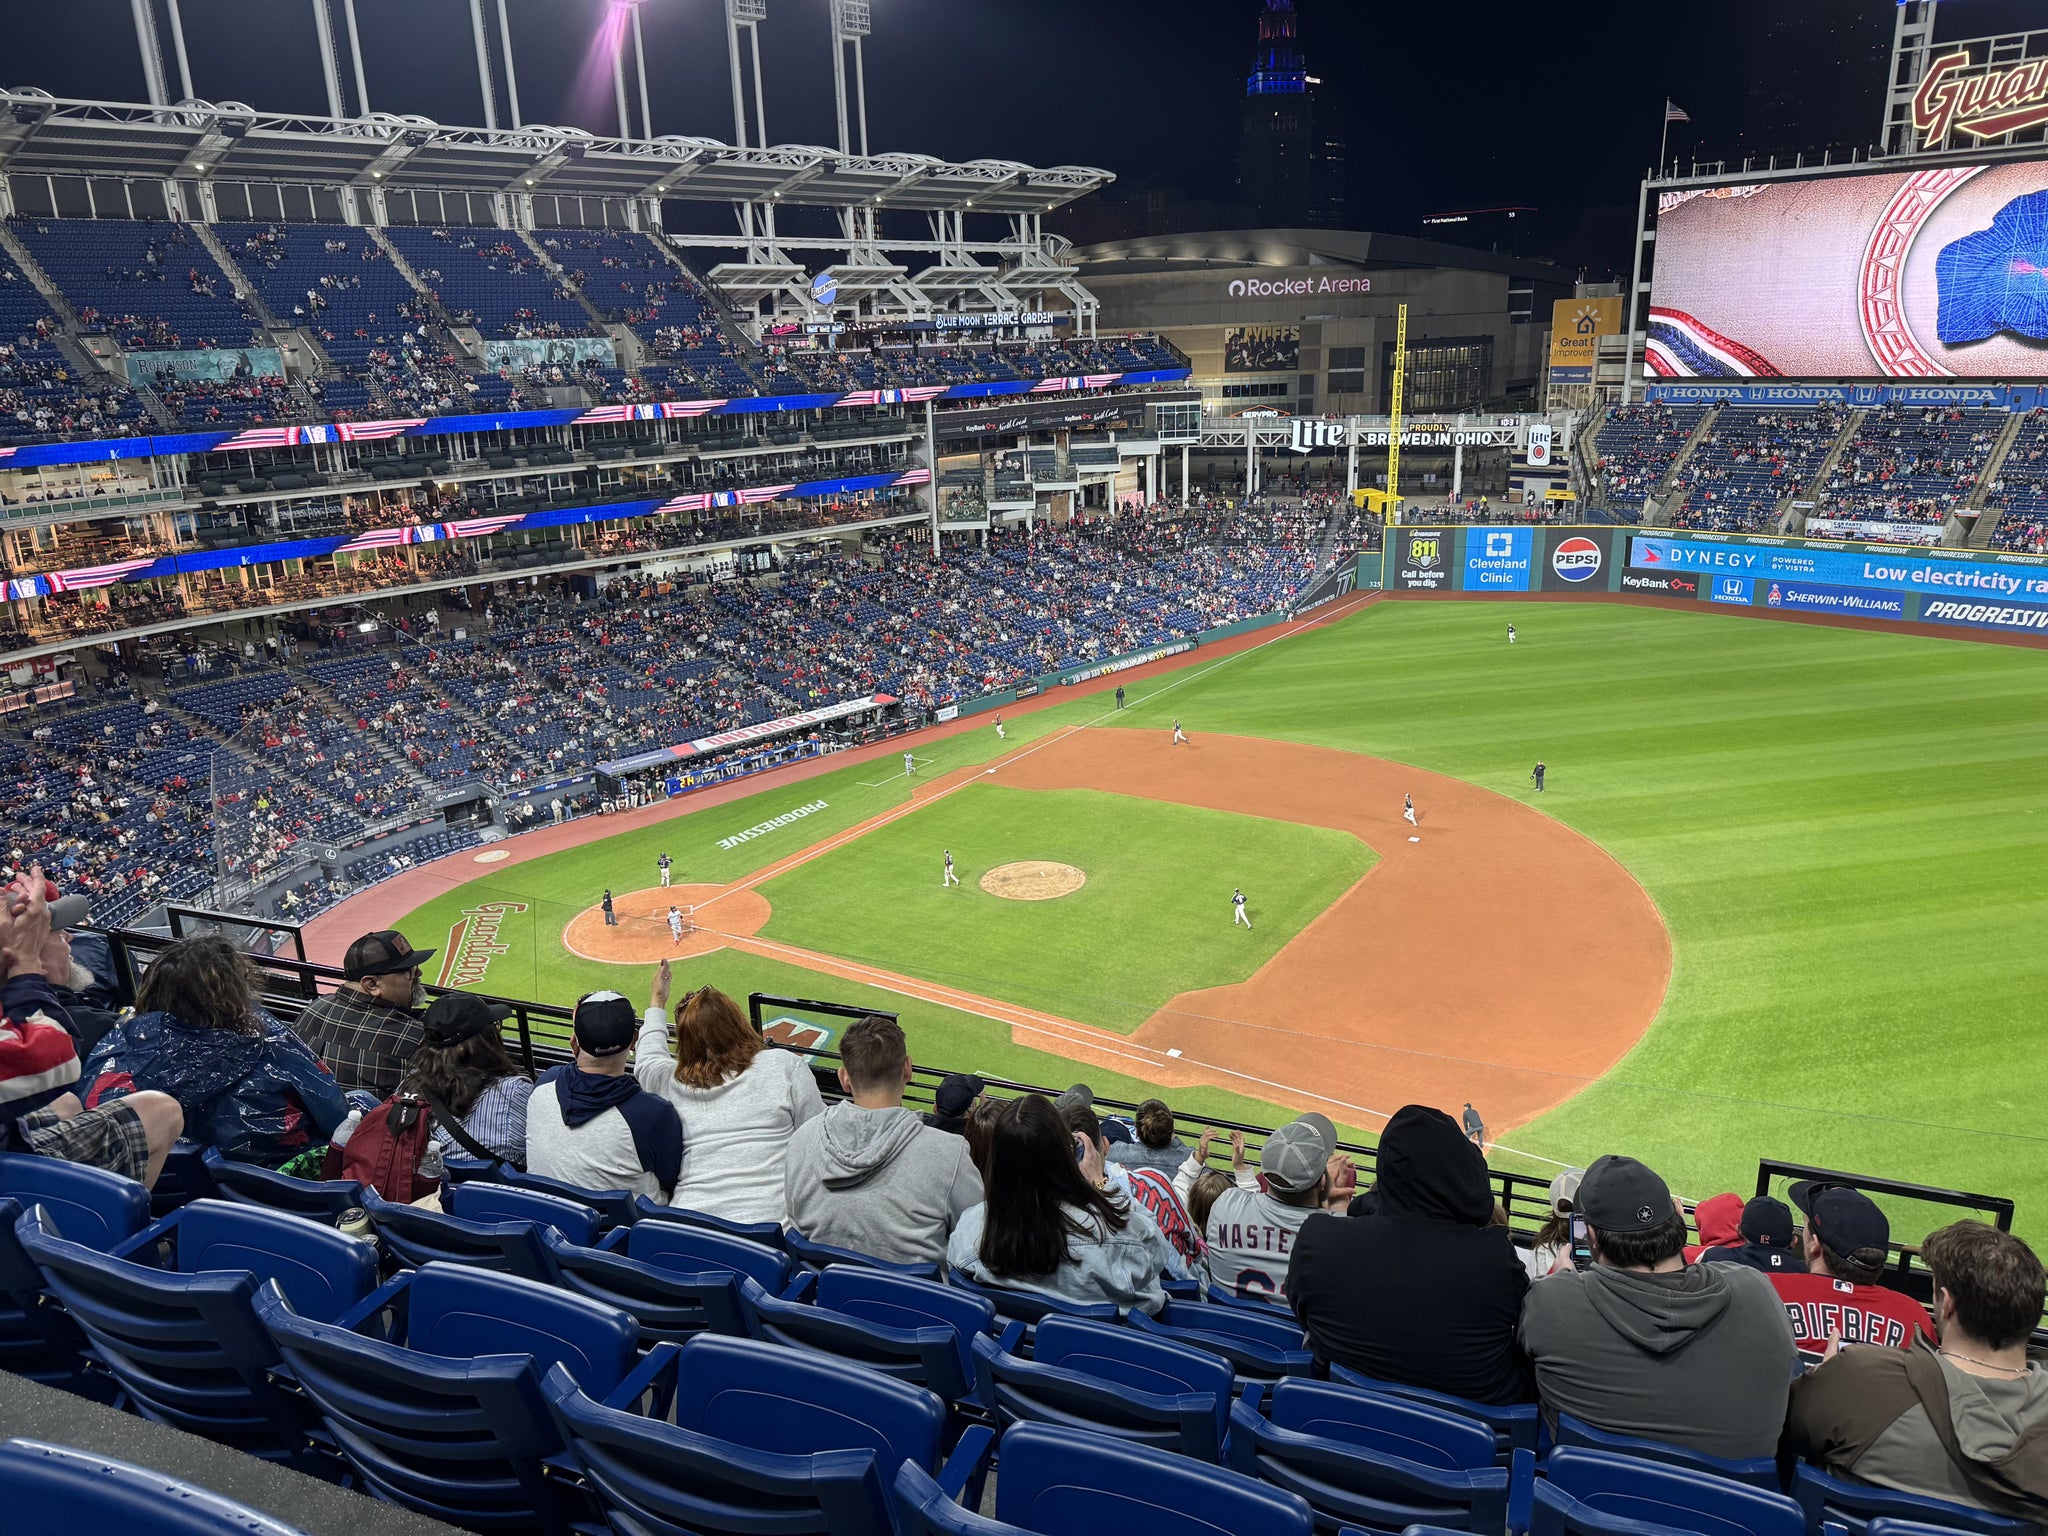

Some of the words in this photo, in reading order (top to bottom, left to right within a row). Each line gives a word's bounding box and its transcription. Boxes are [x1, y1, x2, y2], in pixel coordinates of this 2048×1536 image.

[1247, 276, 1314, 296] Rocket
[1318, 276, 1371, 294] Arena
[936, 314, 957, 329] BLUE
[959, 316, 980, 326] MOON
[982, 313, 1019, 326] TERRACE
[1020, 312, 1054, 324] GARDEN
[1225, 325, 1300, 344] PLAYOFFS
[1560, 337, 1589, 347] Great
[136, 359, 198, 374] ROBINSON
[1672, 388, 1744, 398] HONDA
[1767, 388, 1845, 399] HONDA
[1909, 389, 1997, 400] HONDA
[1242, 410, 1278, 418] SERVPRO
[1409, 424, 1450, 432] PROUDLY
[1289, 420, 1344, 454] Lite
[1434, 432, 1450, 446] IN
[1454, 432, 1492, 446] OHIO
[1530, 431, 1550, 444] Lite
[1638, 529, 1676, 538] PROGRESSIVE
[1690, 533, 1730, 542] PROGRESSIVE
[1746, 536, 1787, 546] PROGRESSIVE
[1804, 540, 1847, 550] PROGRESSIVE
[1412, 540, 1436, 558] 811
[1864, 545, 1910, 555] PROGRESSIVE
[1556, 554, 1598, 565] PEPSI
[1671, 549, 1756, 568] DYNEGY
[1772, 556, 1815, 565] POWERED
[1928, 550, 1977, 560] PROGRESSIVE
[1996, 554, 2047, 564] PROGRESSIVE
[1469, 558, 1527, 570] Cleveland
[1786, 565, 1816, 573] VISTRA
[1402, 570, 1417, 578] Call
[1419, 570, 1444, 578] before
[1480, 572, 1513, 584] Clinic
[1864, 562, 1908, 581] Low
[1912, 566, 2022, 595] electricity
[1408, 580, 1422, 588] you
[1423, 579, 1438, 588] dig.
[1622, 576, 1669, 590] KeyBank
[1714, 594, 1749, 603] HONDA
[705, 714, 817, 746] CLEVELAND
[715, 800, 830, 850] PROGRESSIVE
[448, 901, 528, 989] Guardians
[1219, 1223, 1298, 1254] MASTE
[1784, 1302, 1905, 1347] BIEBER
